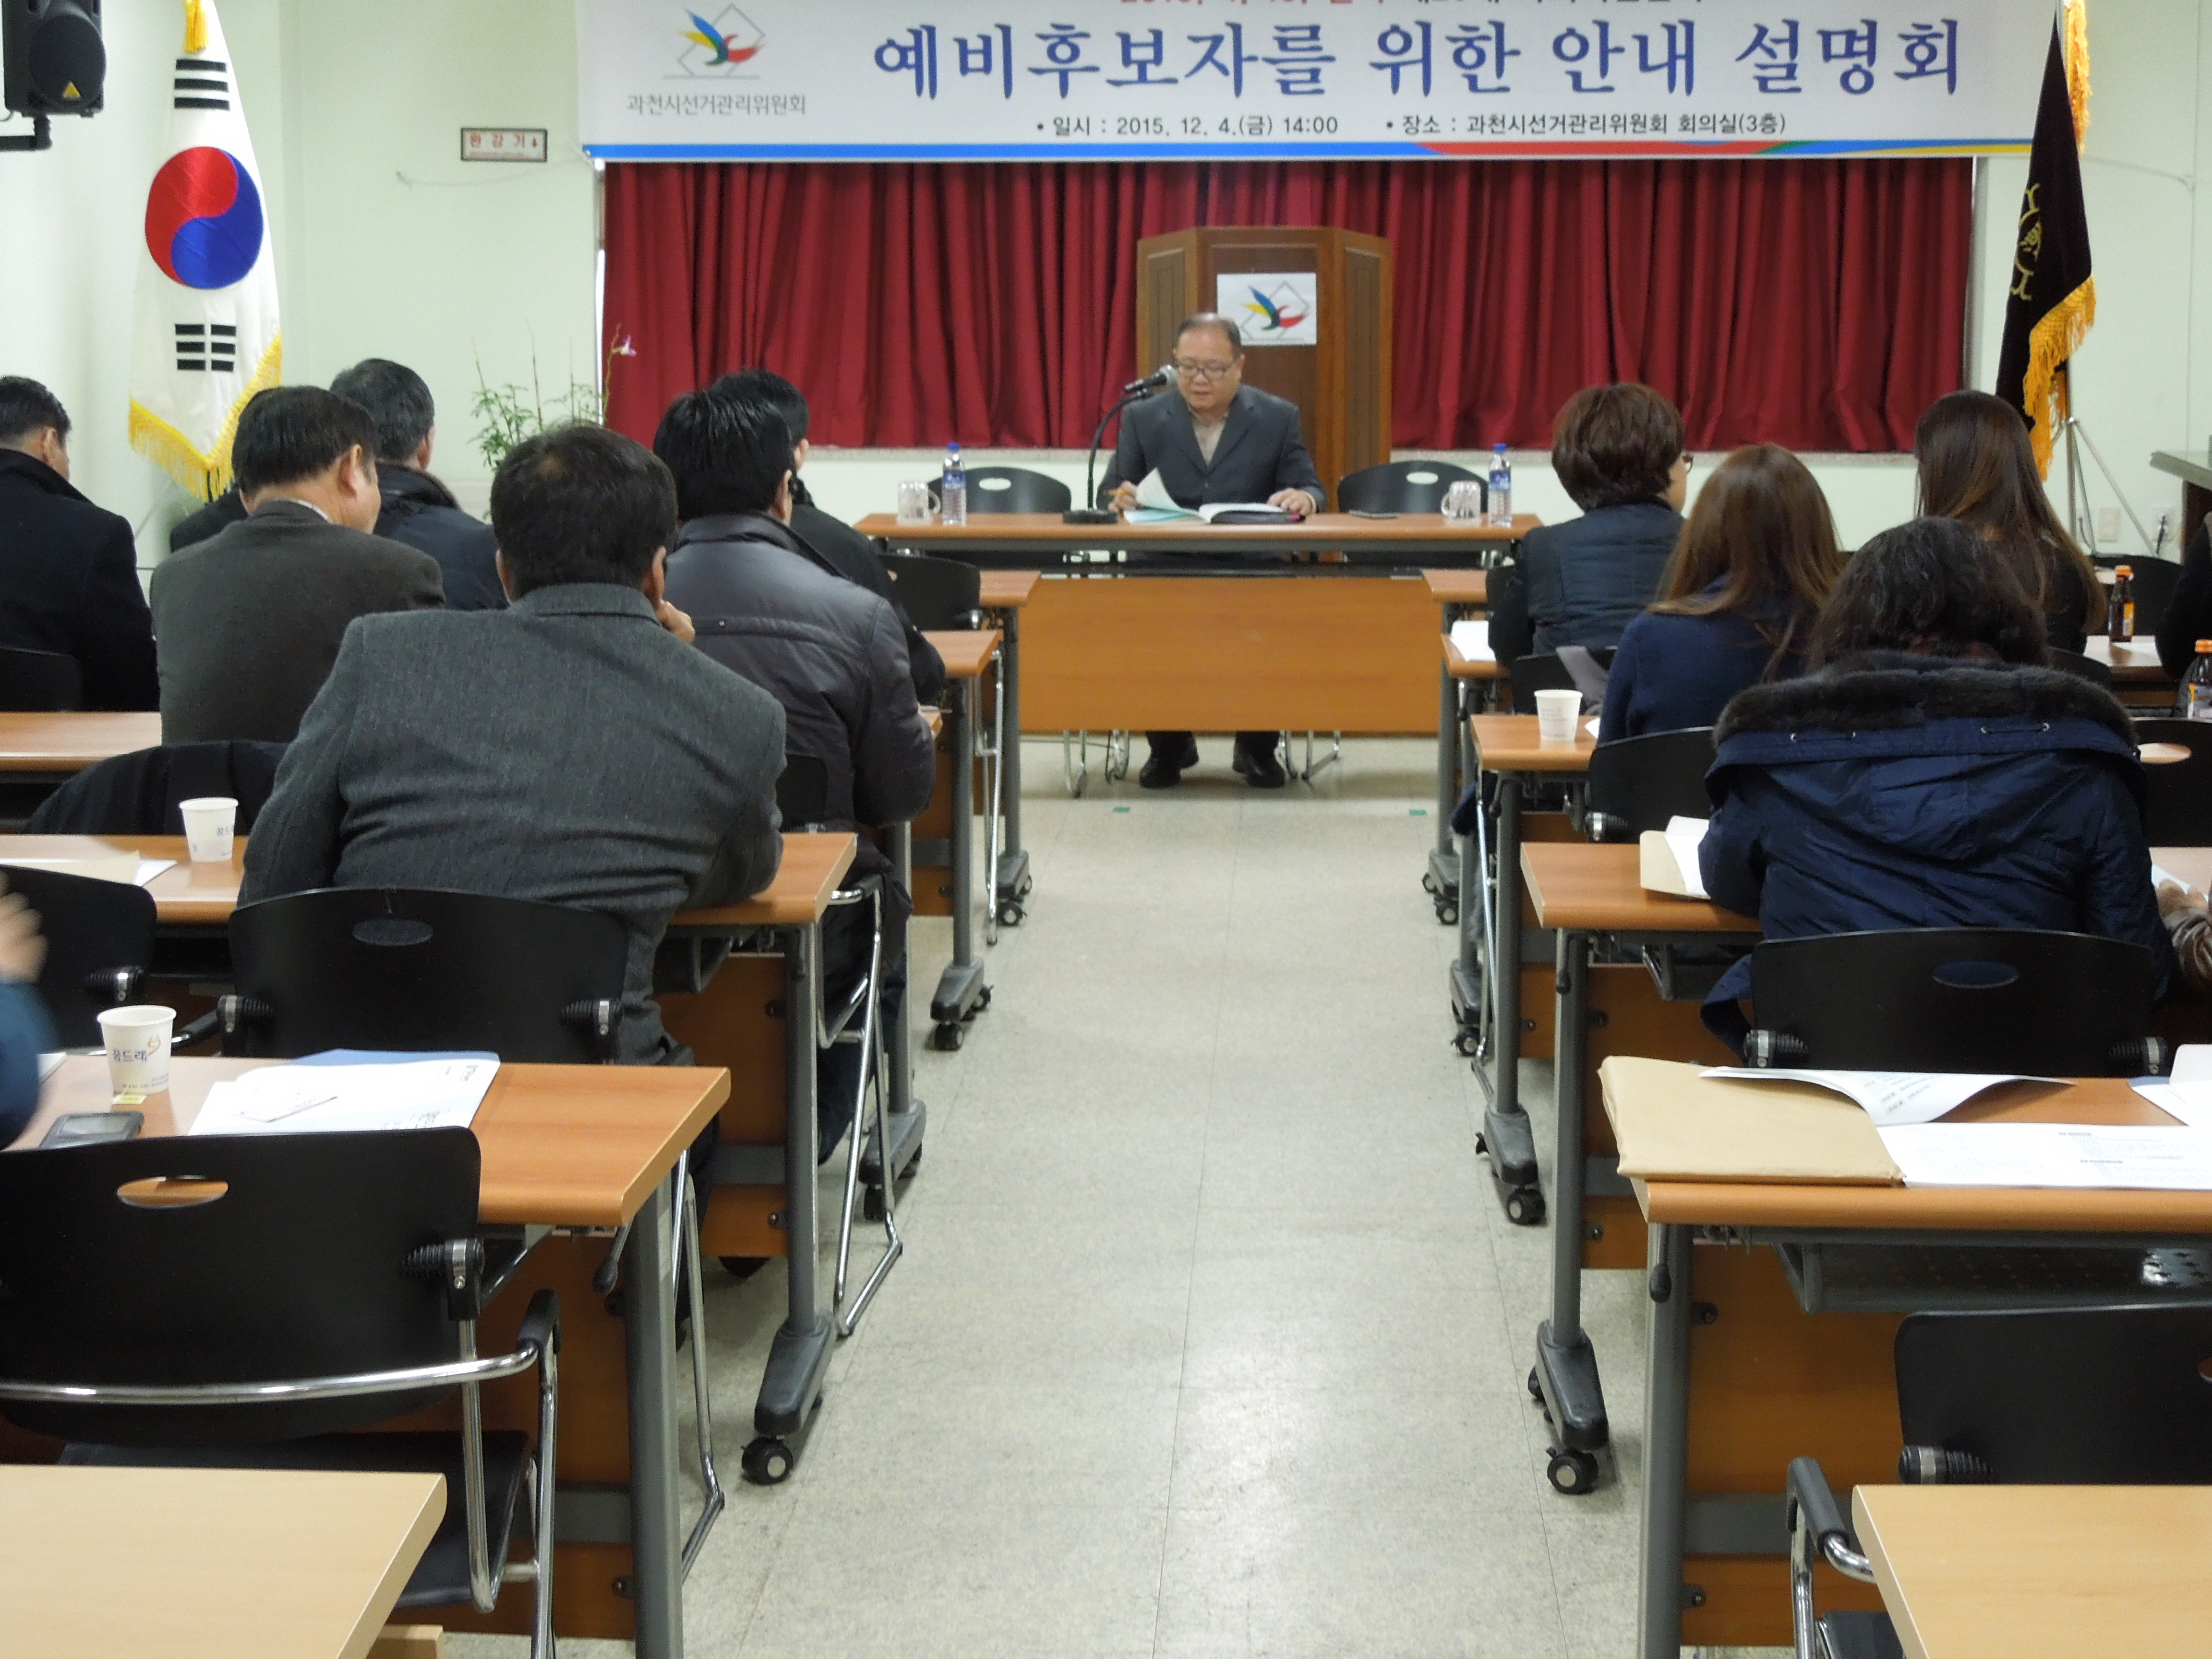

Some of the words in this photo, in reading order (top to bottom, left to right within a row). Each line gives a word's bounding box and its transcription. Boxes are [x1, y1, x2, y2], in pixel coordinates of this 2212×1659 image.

[874, 21, 1336, 100] 예비후보자를
[1369, 20, 1521, 97] 위한
[1552, 19, 1695, 96] 안내
[1735, 18, 1958, 95] 설명회
[627, 94, 806, 116] 과천시선거관리위원회
[1053, 116, 1091, 137] 일시
[1117, 117, 1170, 136] 2015.
[1180, 117, 1208, 136] 12.
[1218, 116, 1273, 136] 4.(금)
[1283, 116, 1338, 134] 14:00
[1402, 114, 1441, 136] 장소
[1467, 113, 1667, 135] 과천시선거관리위원회
[1678, 113, 1786, 135] 회의실(3층)
